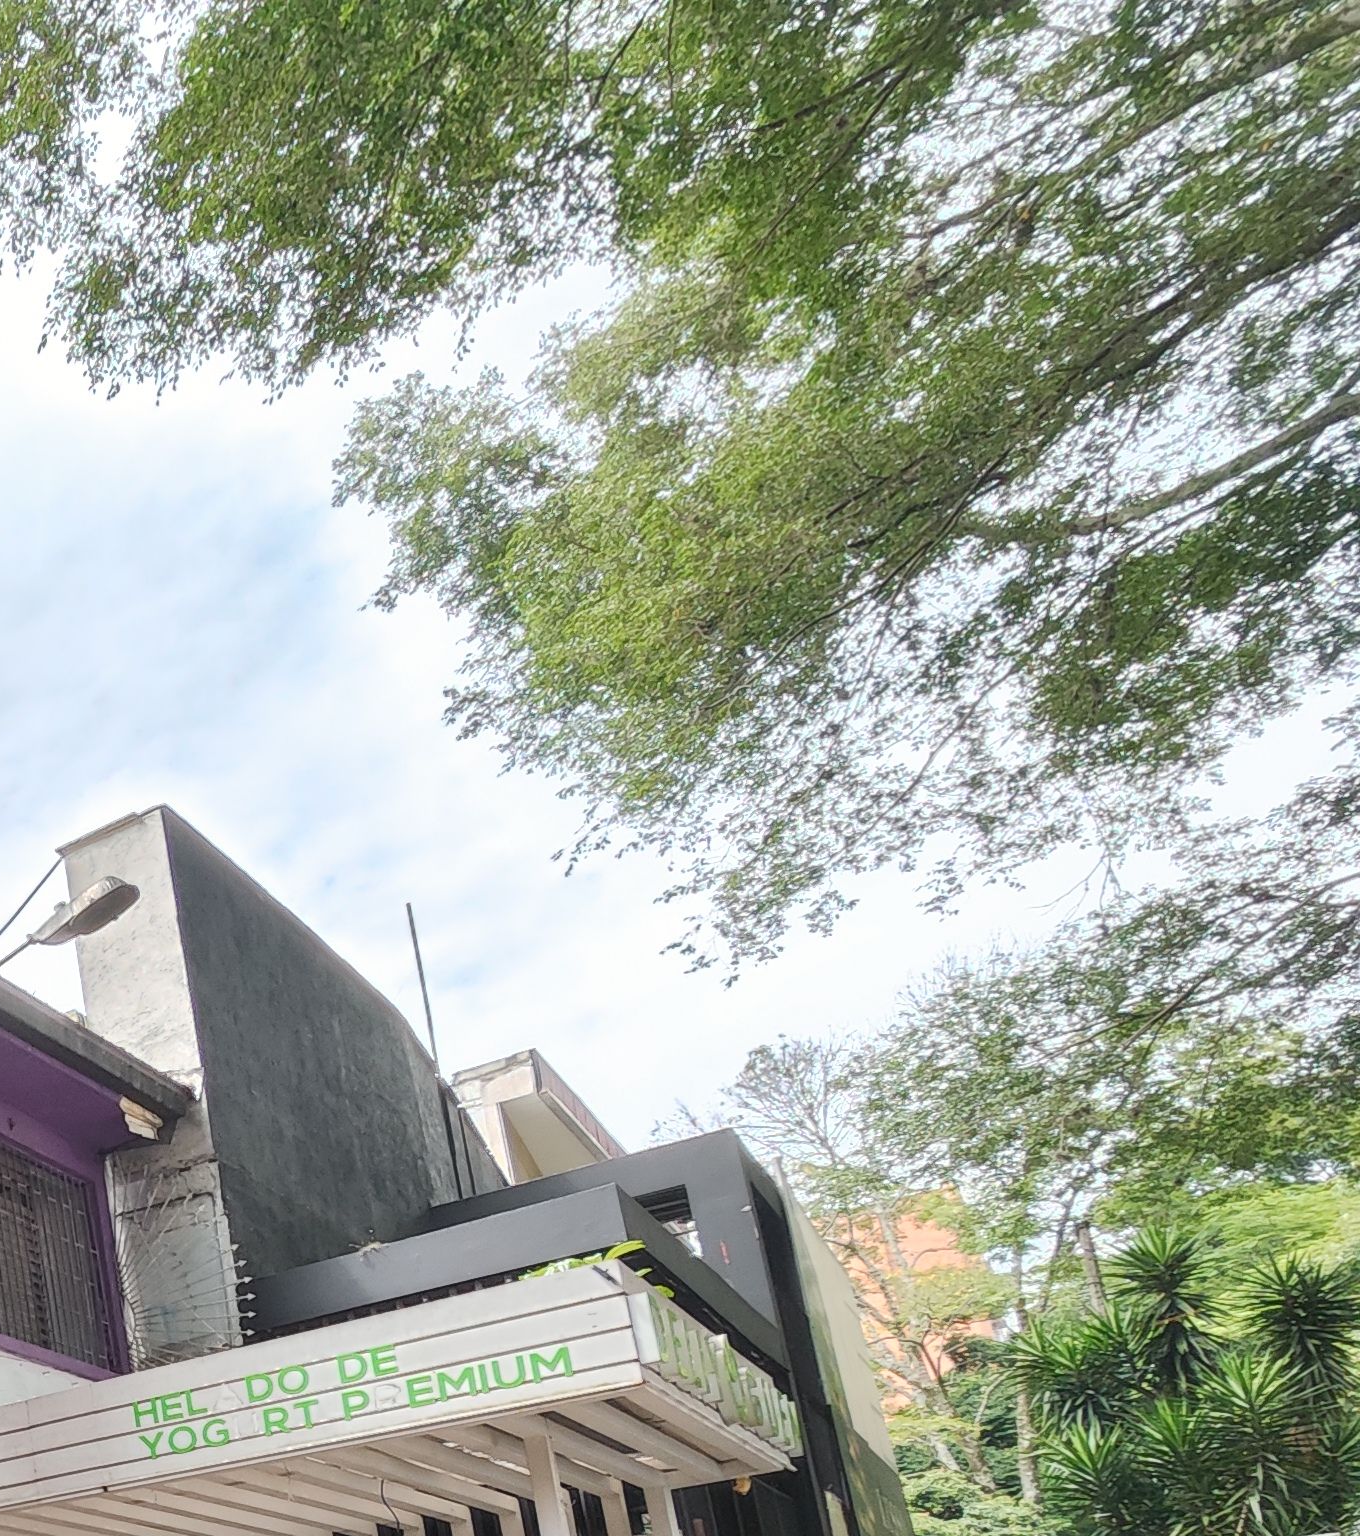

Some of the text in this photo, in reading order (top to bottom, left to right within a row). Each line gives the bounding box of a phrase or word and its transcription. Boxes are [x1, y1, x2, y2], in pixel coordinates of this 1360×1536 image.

[132, 1344, 399, 1428] HELDO DE
[138, 1398, 319, 1460] YOGRT
[341, 1345, 574, 1421] PEMIUM
